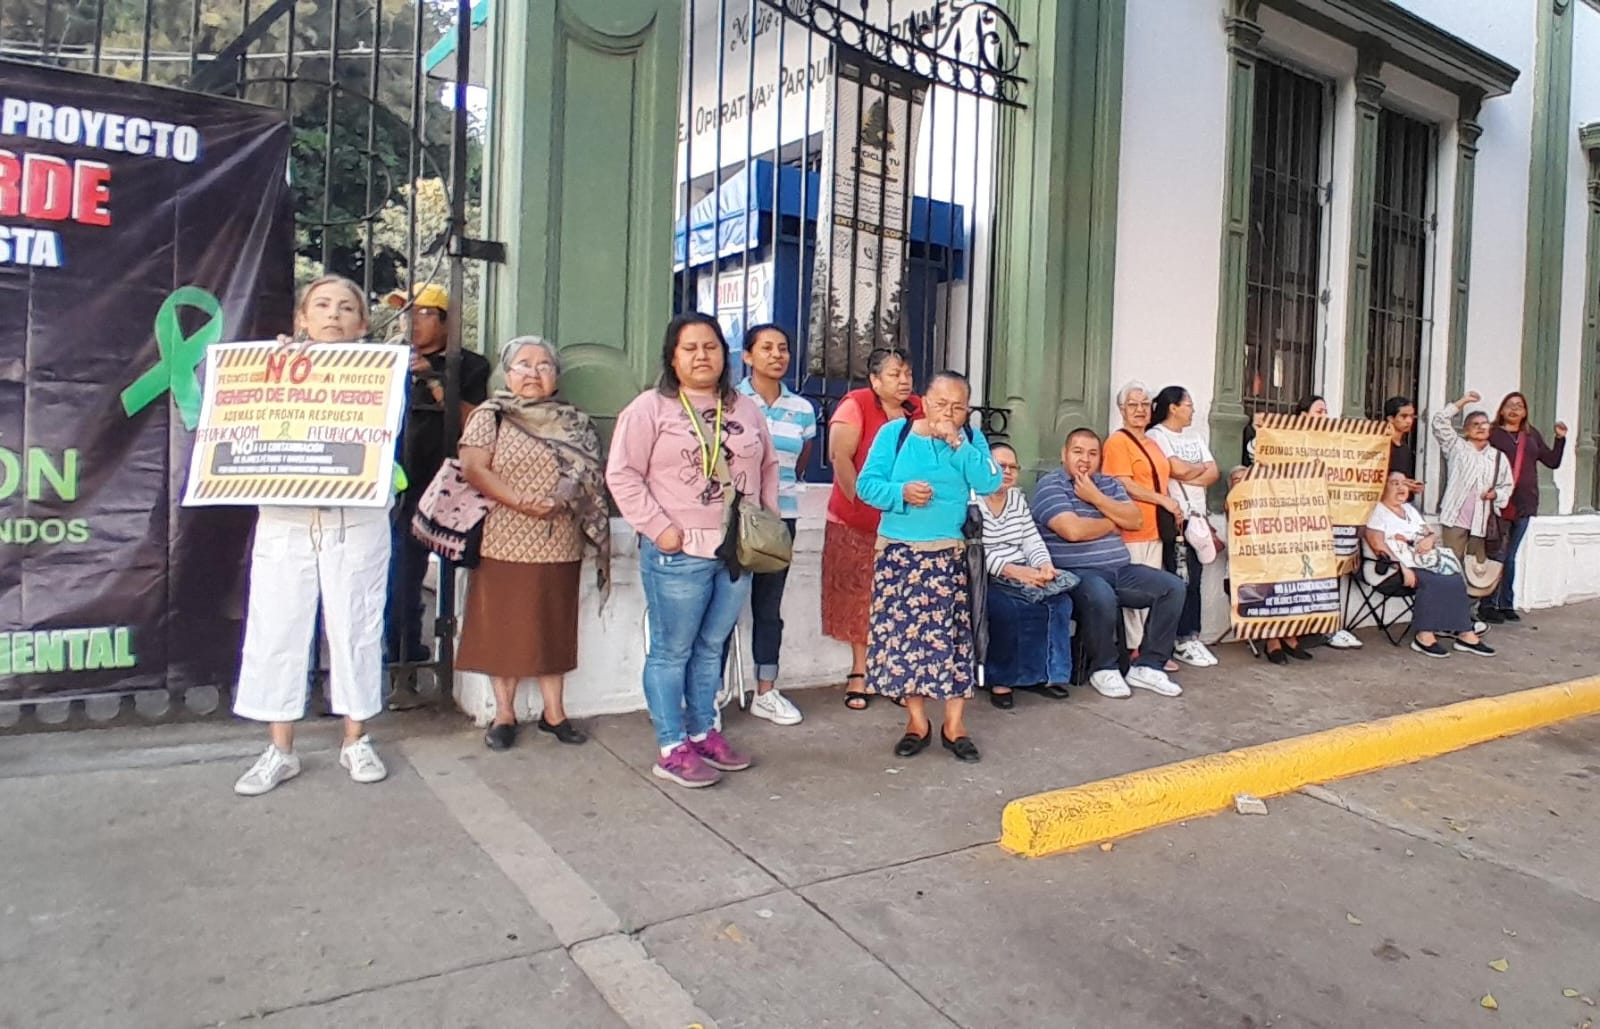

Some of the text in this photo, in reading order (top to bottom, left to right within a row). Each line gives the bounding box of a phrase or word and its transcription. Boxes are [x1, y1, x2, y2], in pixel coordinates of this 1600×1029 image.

[696, 86, 766, 135] OPERATVA
[2, 98, 198, 162] PROYECTO
[264, 352, 312, 384] NO
[339, 375, 386, 385] PROYECTO
[266, 387, 285, 404] DE
[288, 389, 327, 405] PALO
[331, 390, 384, 406] VERDE
[269, 409, 305, 422] PRONTA
[308, 409, 364, 422] RESPUESTA
[231, 439, 252, 456] NO
[1260, 445, 1294, 457] PEDIMOS
[1327, 467, 1385, 484] PALO VERDE
[1312, 496, 1327, 506] DEL
[1284, 516, 1297, 533] EN
[1300, 515, 1328, 533] PALO
[1239, 541, 1277, 556] ADEMÁS
[1289, 540, 1320, 554] PRONTA
